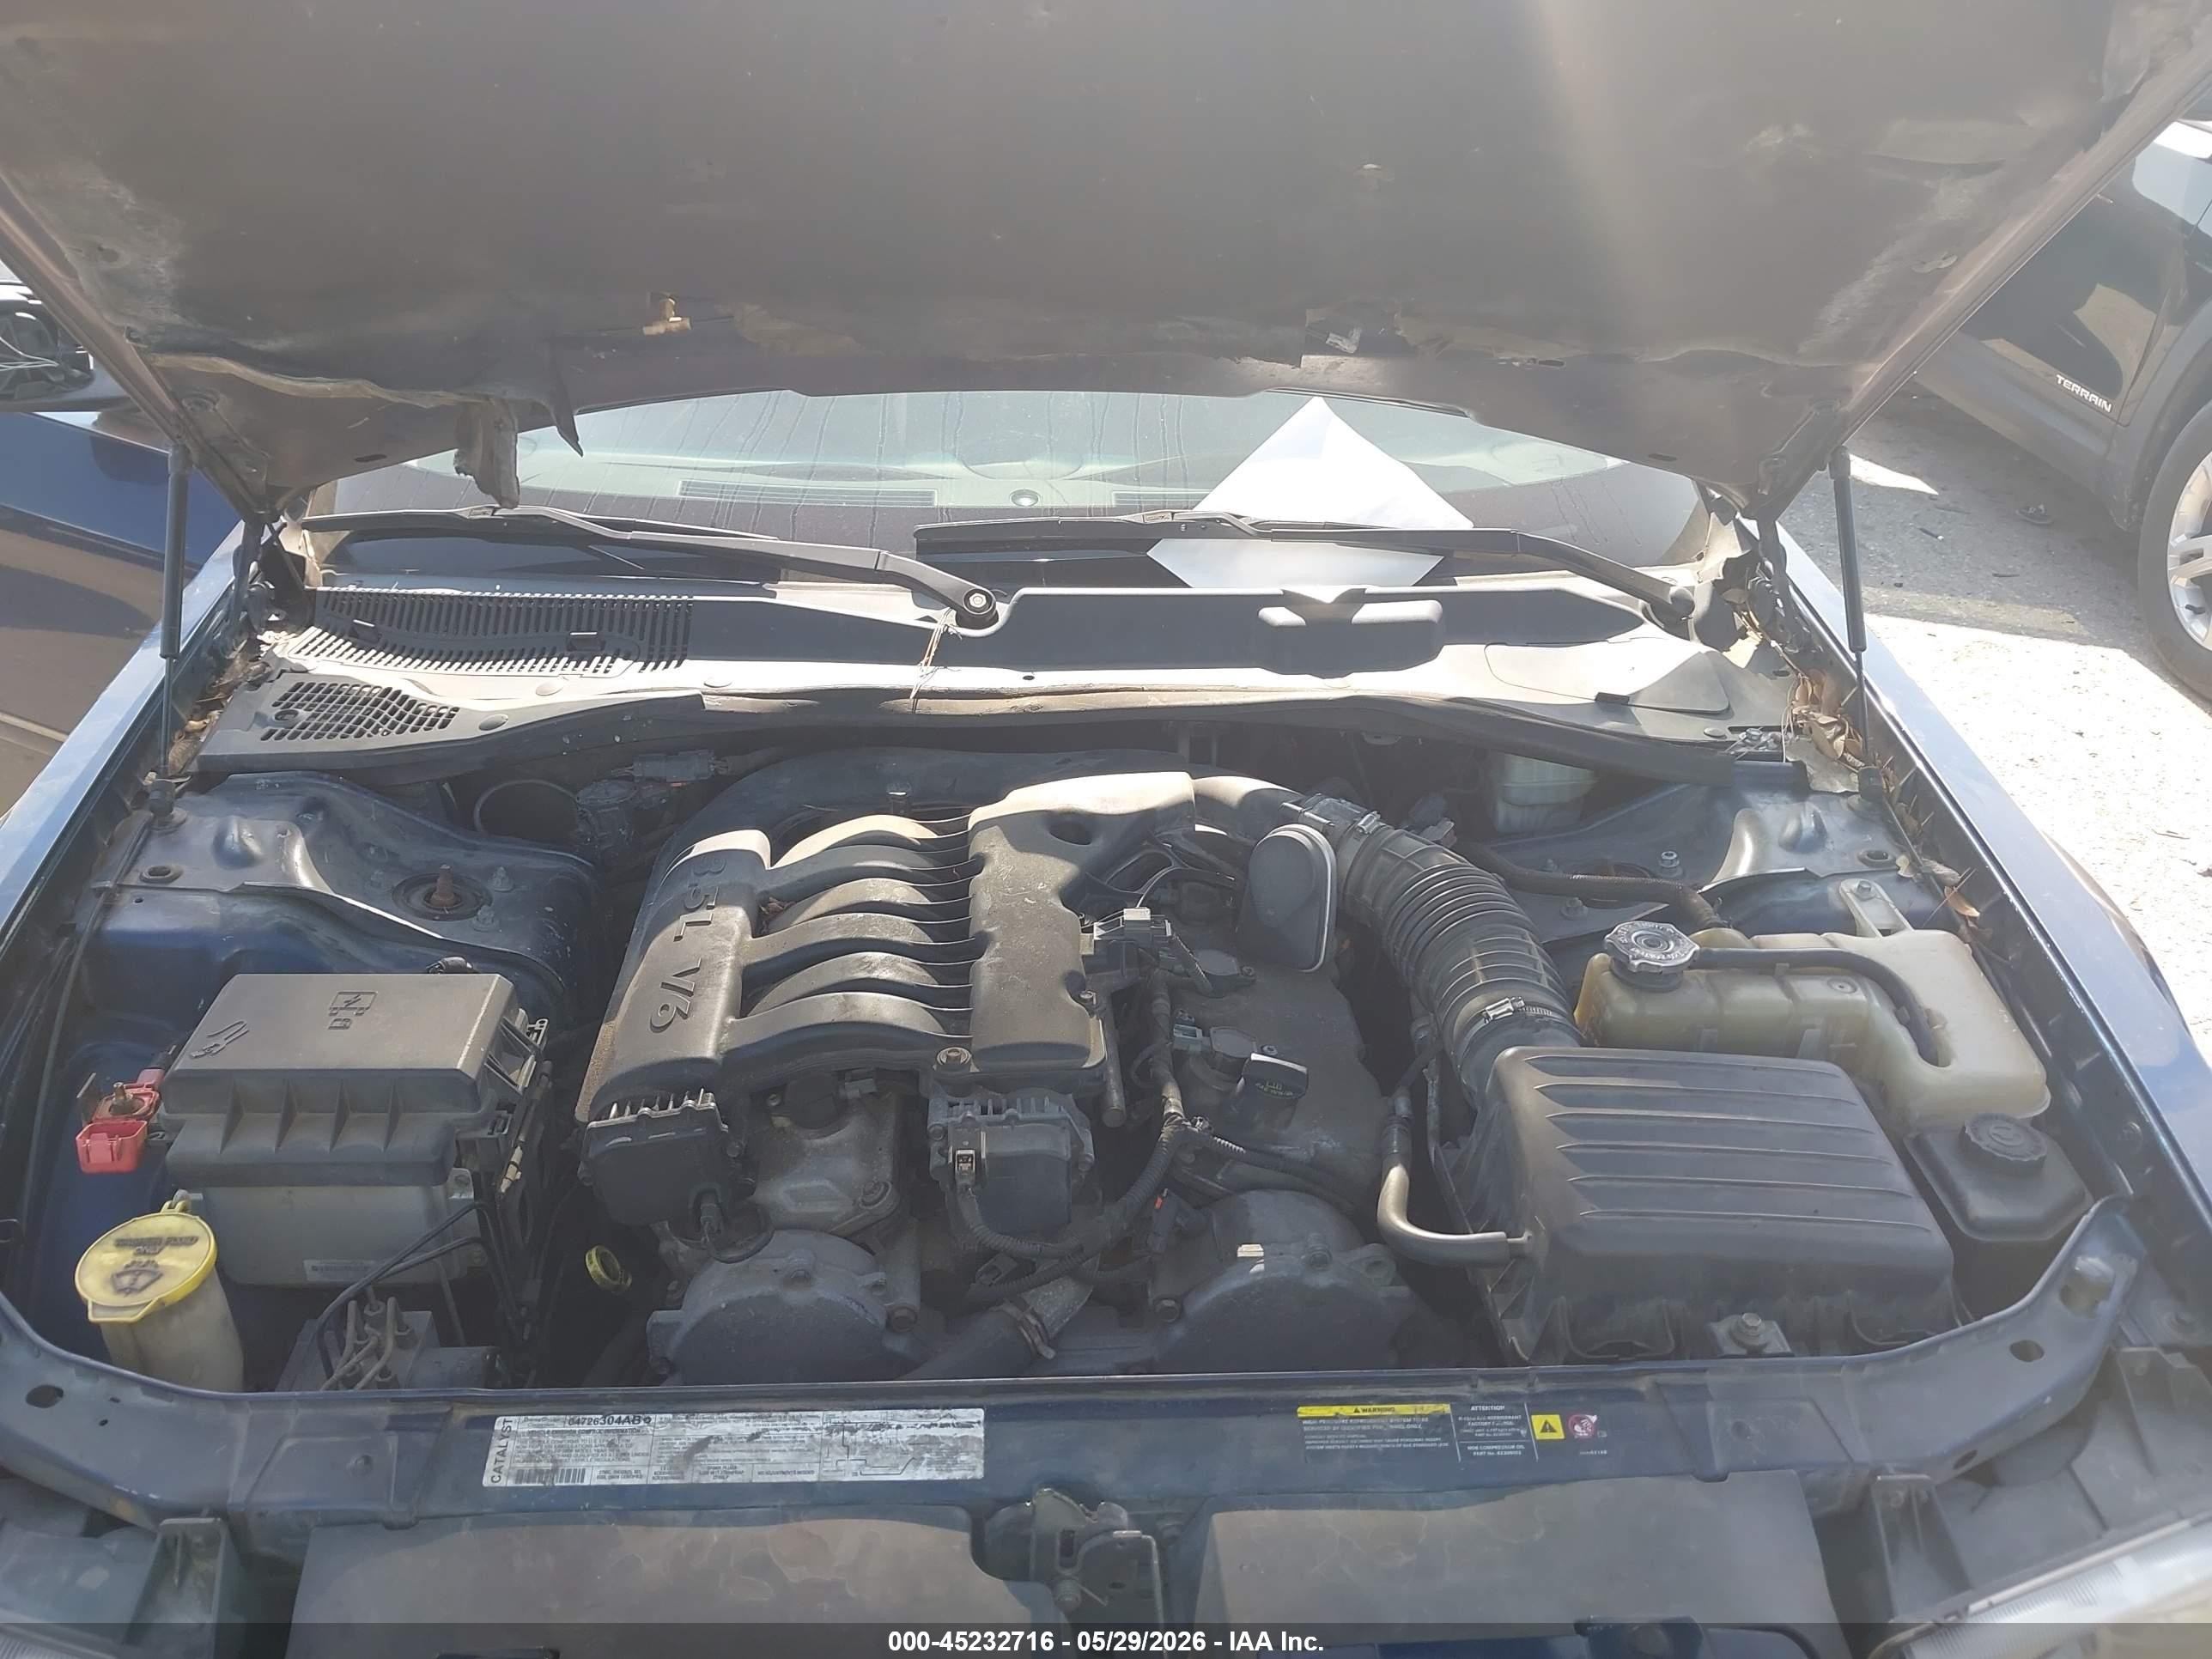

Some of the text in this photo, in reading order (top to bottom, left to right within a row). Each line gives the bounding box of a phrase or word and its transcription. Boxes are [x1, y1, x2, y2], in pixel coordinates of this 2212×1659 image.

[2056, 374, 2112, 413] TERRAIN
[649, 957, 702, 1033] V6
[568, 1414, 641, 1426] 04726304AB
[490, 1418, 514, 1484] CATALYST
